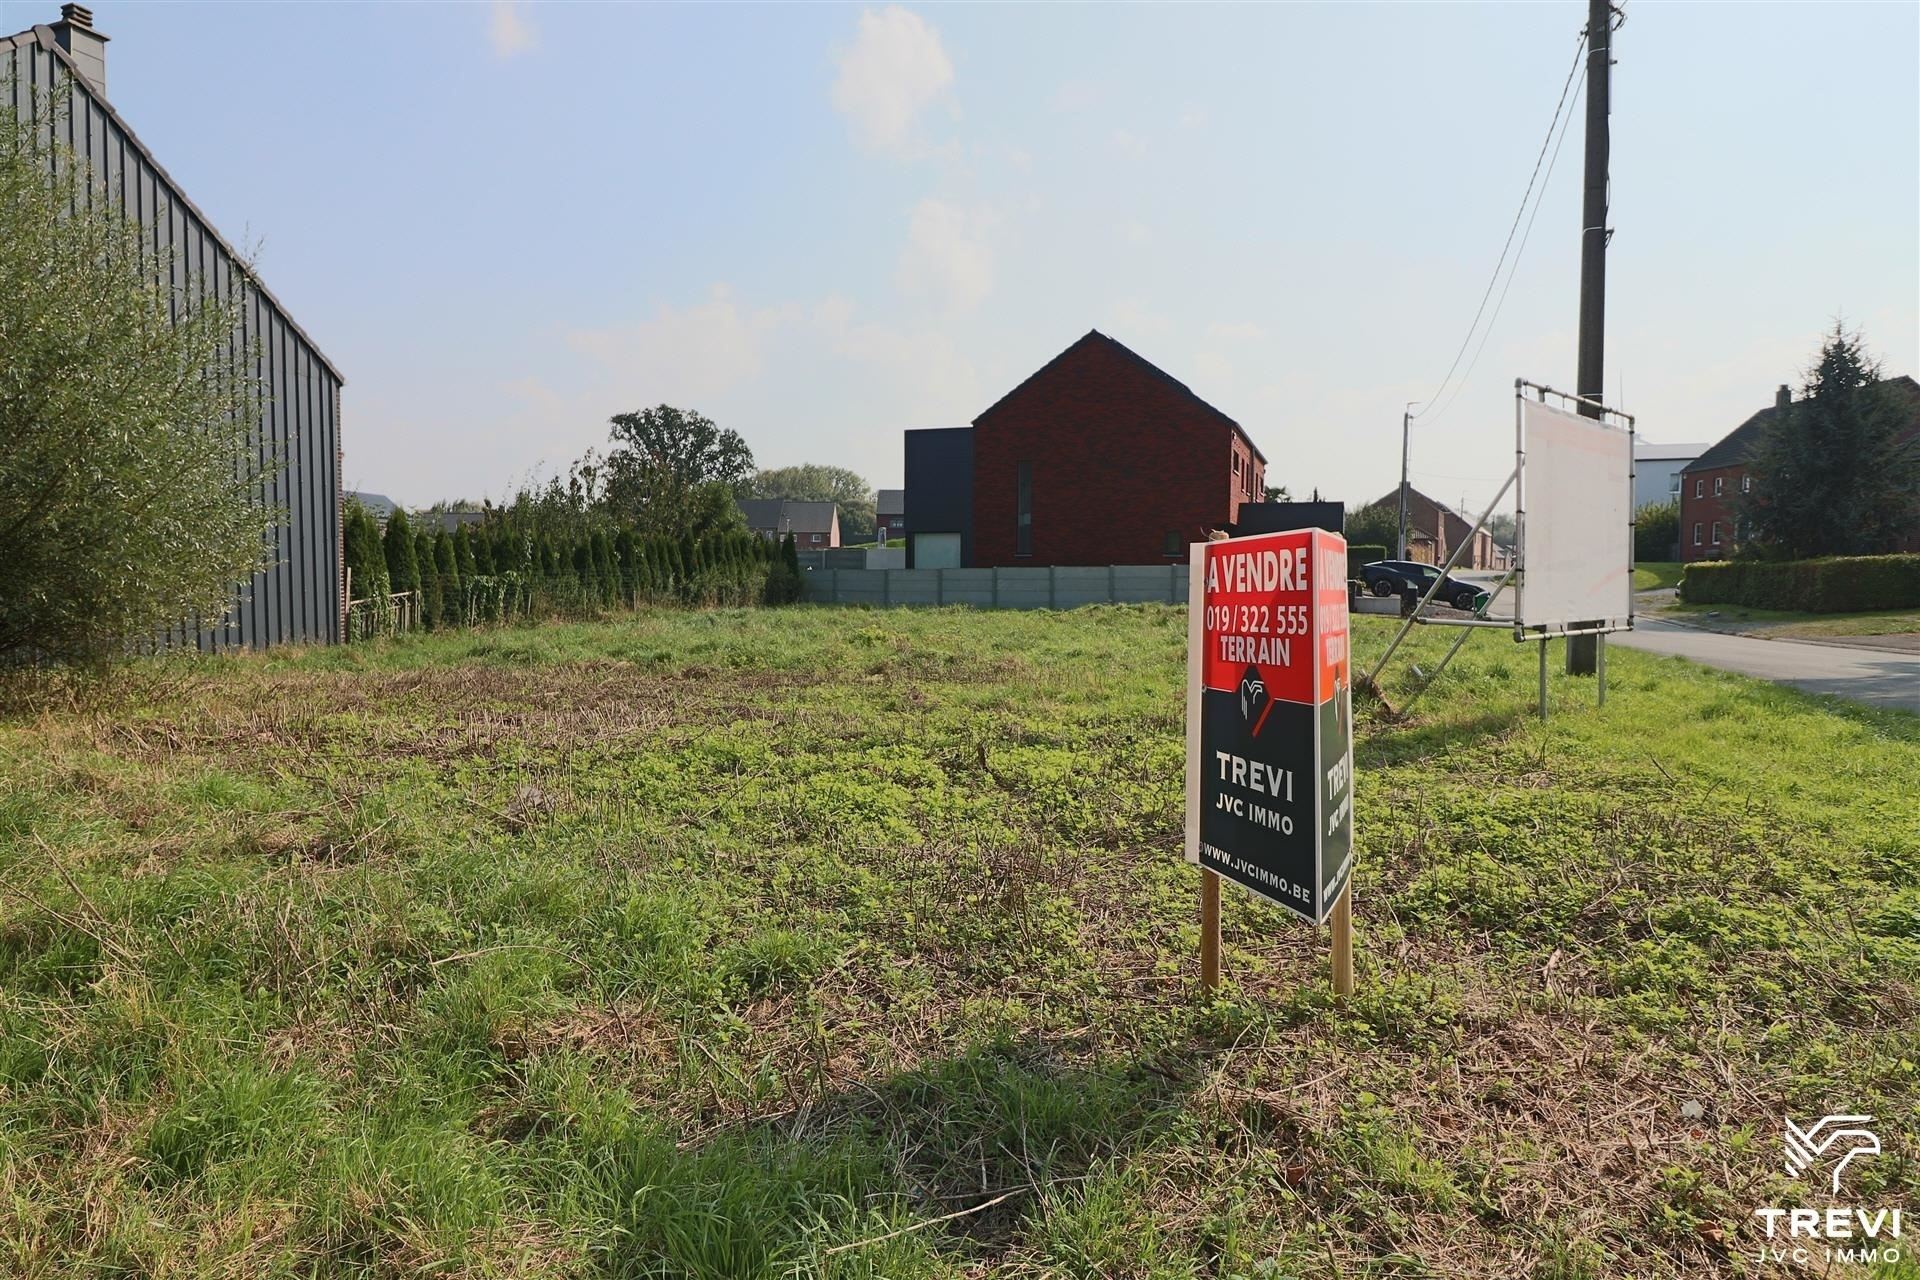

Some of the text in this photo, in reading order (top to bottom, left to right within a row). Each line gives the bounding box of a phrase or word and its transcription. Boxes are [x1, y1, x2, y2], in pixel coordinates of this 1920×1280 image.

[1207, 547, 1307, 594] A VENDRE
[1276, 605, 1308, 636] 555
[1220, 635, 1290, 667] TERRAIN
[1216, 750, 1293, 802] TREVI
[1216, 792, 1294, 836] JVC IMMO
[1203, 843, 1310, 904] WWW.JVCIMMO.BE
